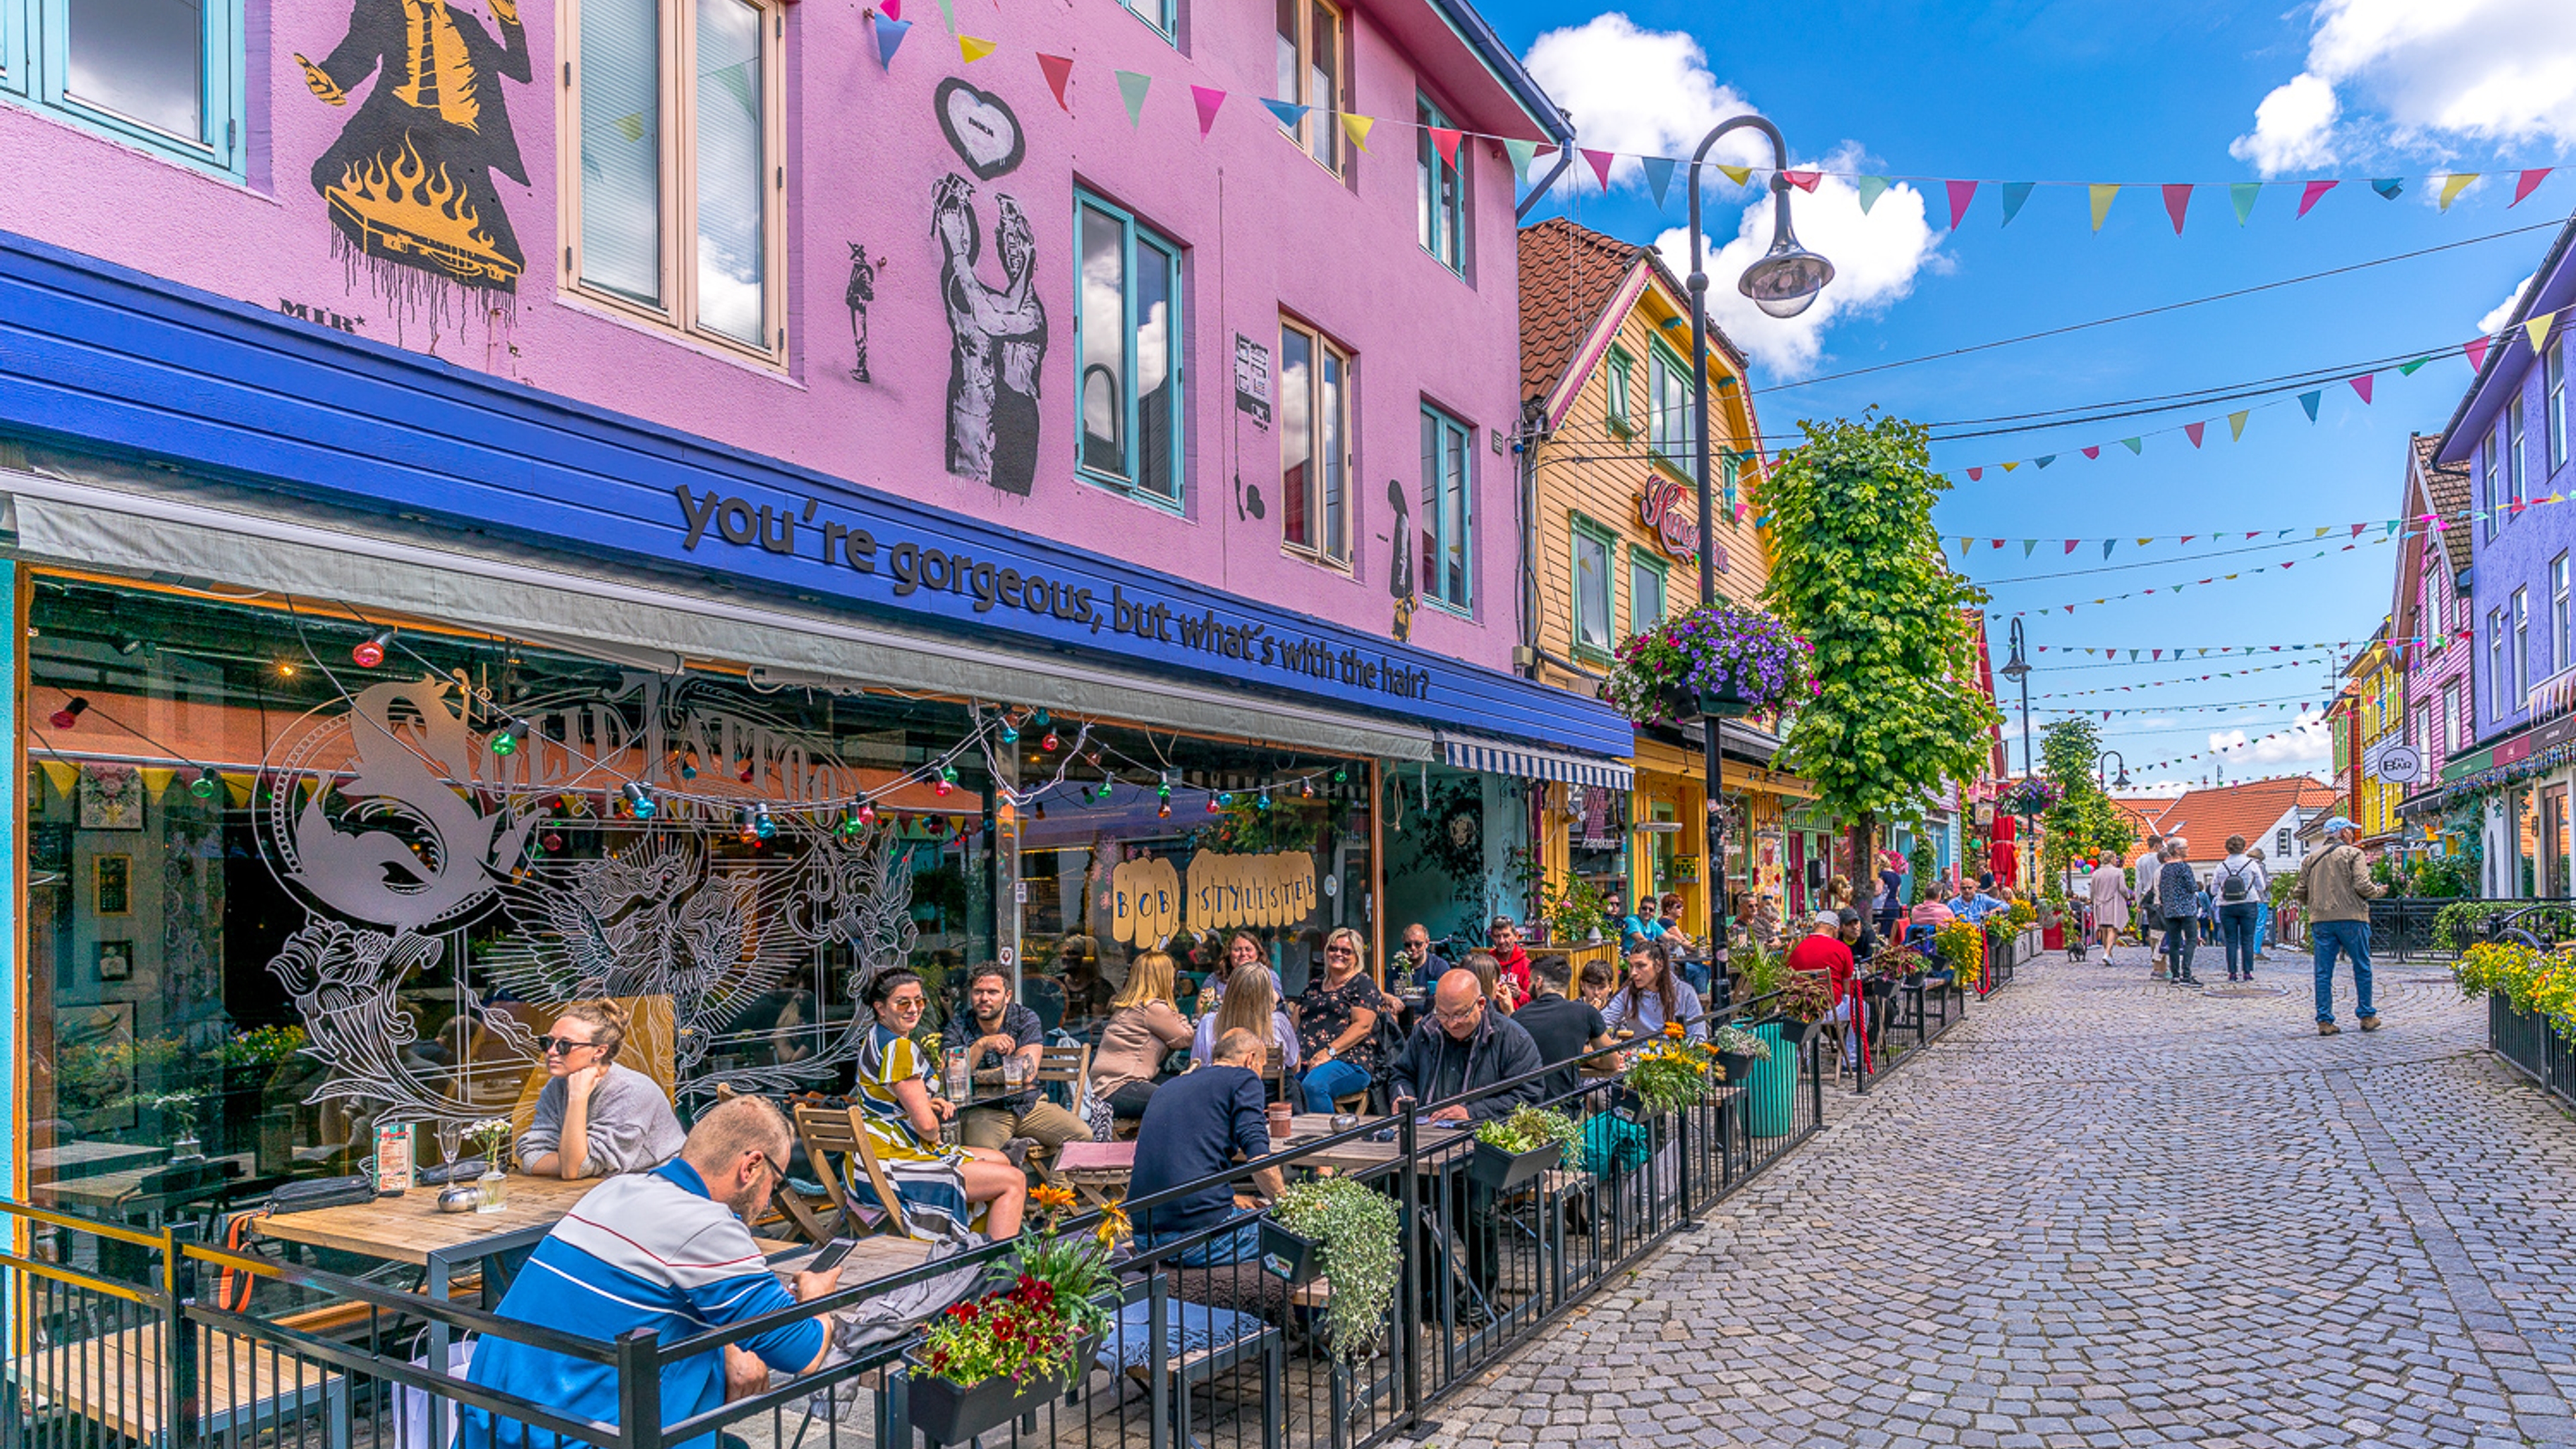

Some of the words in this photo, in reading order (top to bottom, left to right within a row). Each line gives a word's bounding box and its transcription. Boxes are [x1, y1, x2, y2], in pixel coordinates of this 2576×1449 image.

[676, 484, 877, 572] you're
[890, 542, 1103, 633] gorgeous,
[1114, 585, 1172, 641] but
[1180, 611, 1274, 665] what's
[1280, 638, 1336, 680] with
[1341, 650, 1377, 689] the
[1381, 657, 1431, 700] hair?
[1116, 890, 1170, 918] BOB
[1200, 874, 1314, 913] STYLISTER
